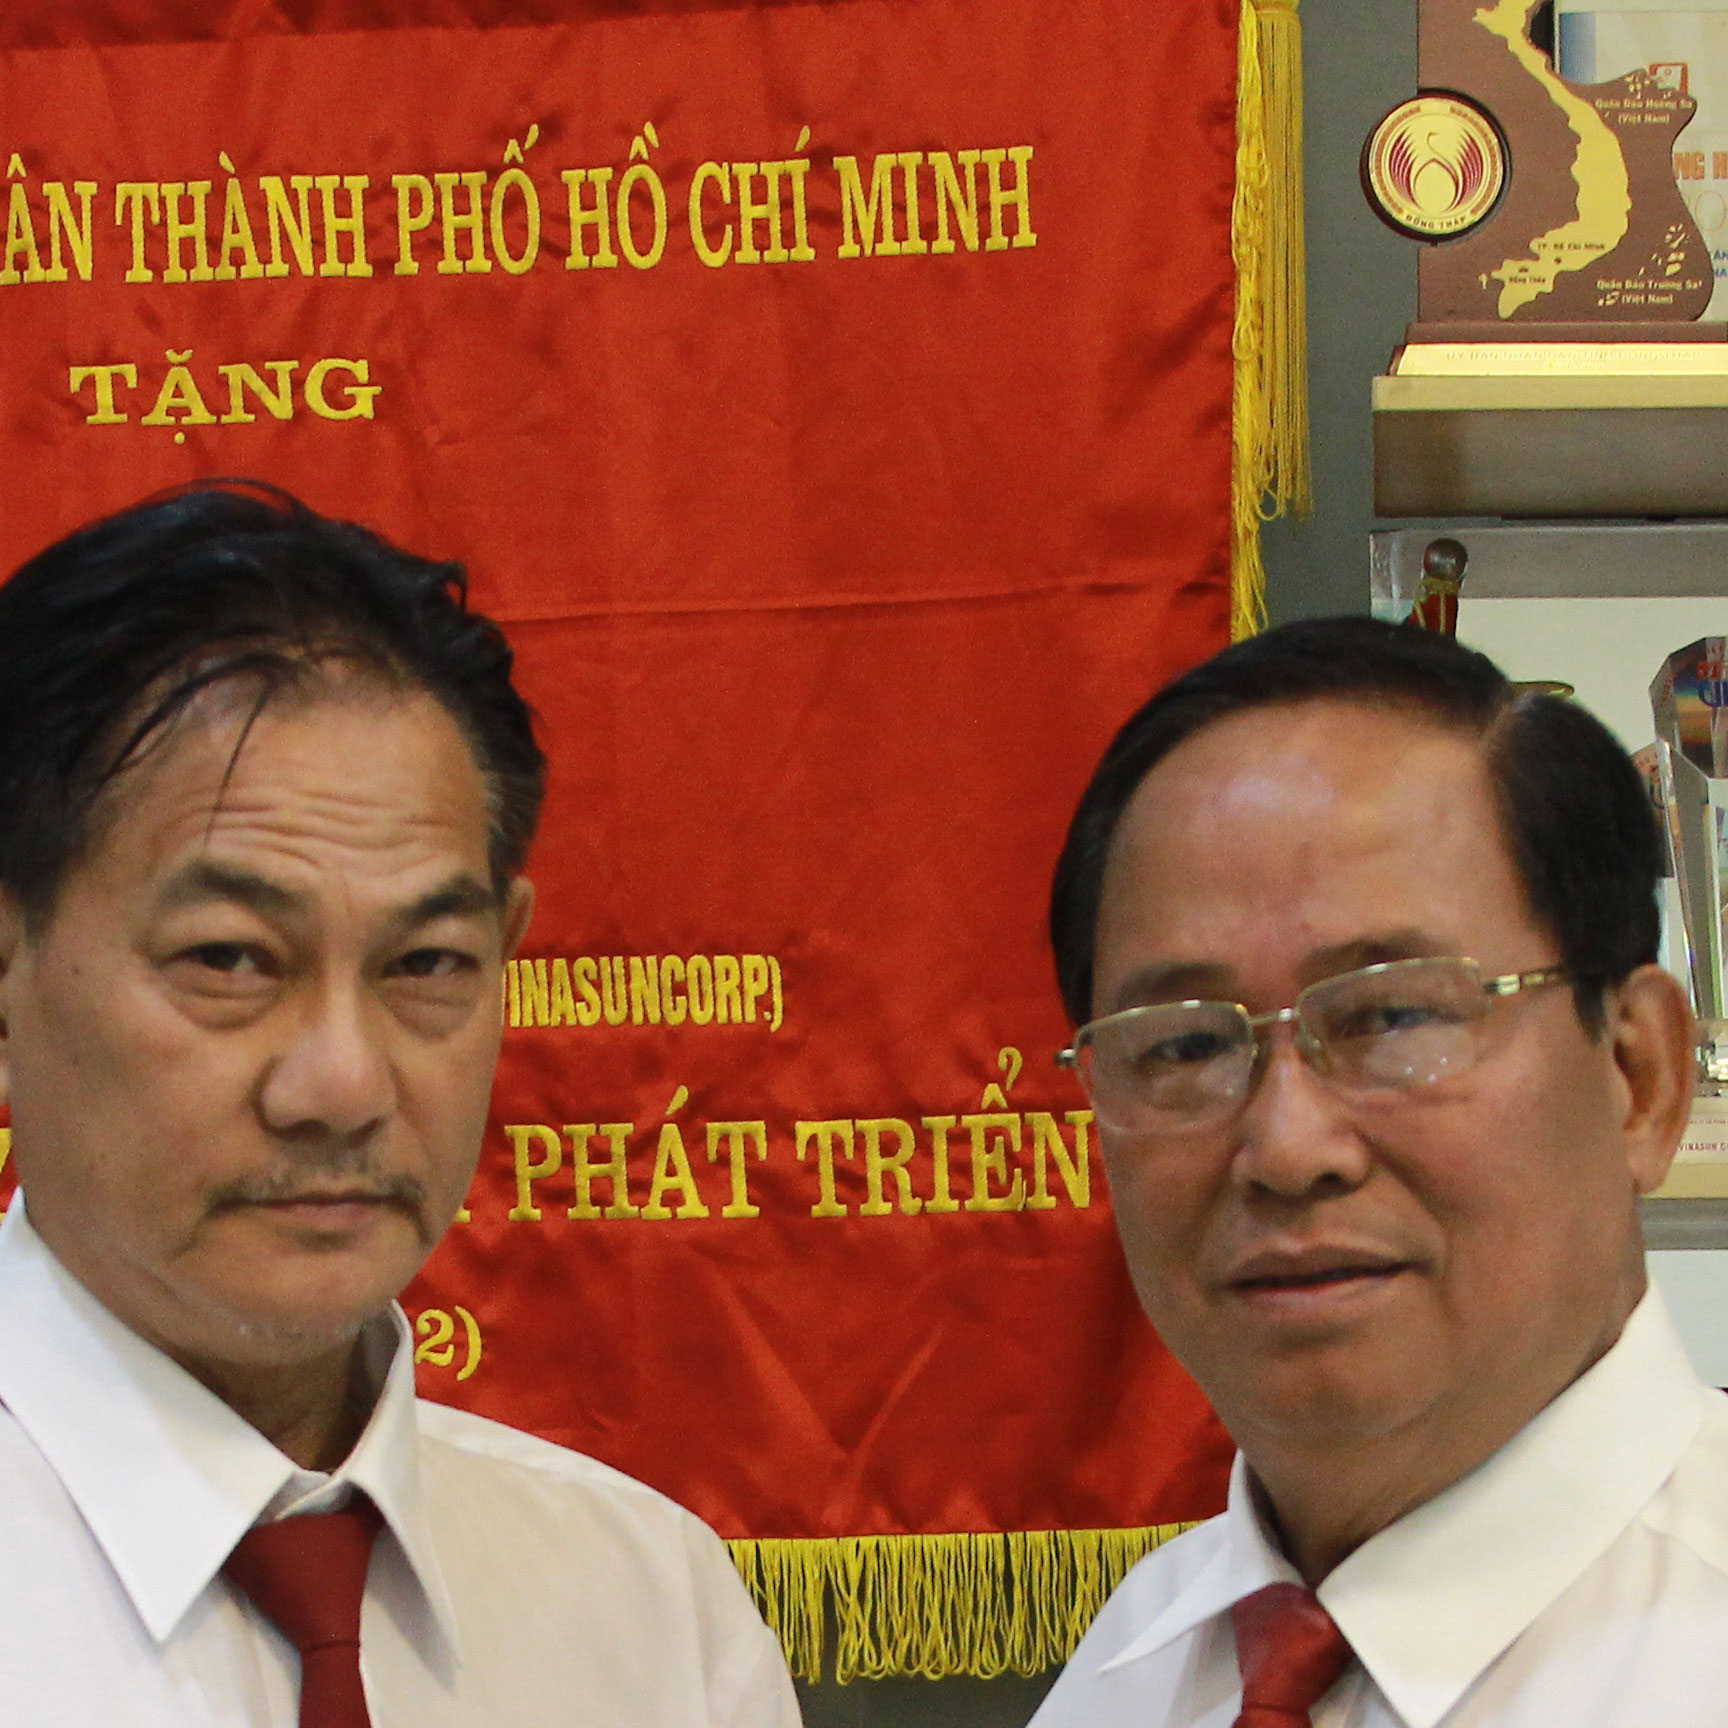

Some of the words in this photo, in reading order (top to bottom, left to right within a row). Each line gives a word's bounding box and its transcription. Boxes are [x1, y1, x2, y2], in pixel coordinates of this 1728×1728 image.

[115, 150, 373, 285] THÀNH
[391, 123, 541, 277] PHỐ
[561, 121, 668, 270] HỒ
[688, 125, 816, 269] CHÍ
[832, 145, 1038, 260] MINH
[70, 348, 382, 445] TẶNG
[503, 953, 784, 1033] INASUNCORP.)
[503, 1085, 769, 1222] PHÁT
[796, 1046, 1096, 1219] TRIỂN
